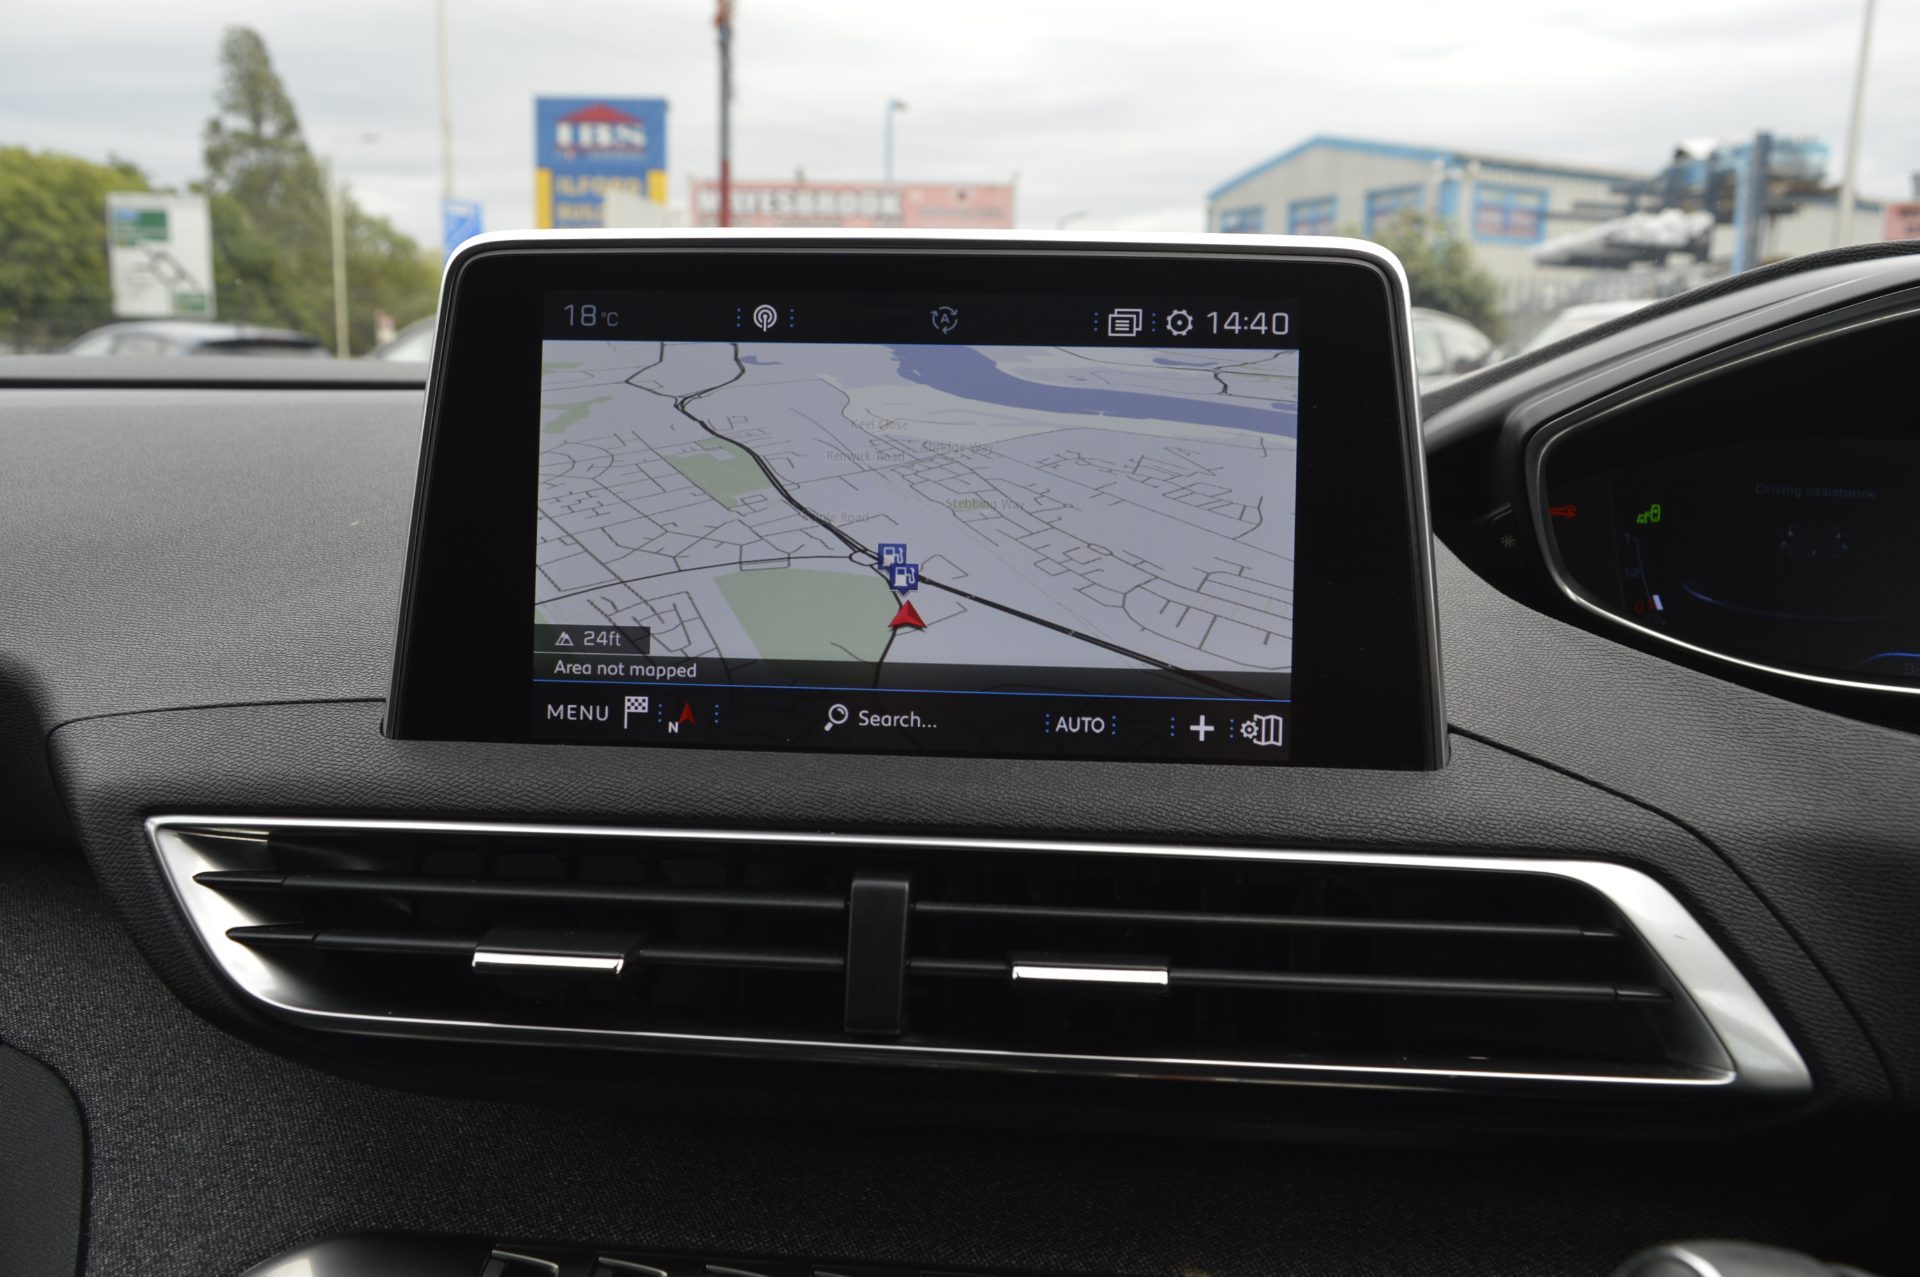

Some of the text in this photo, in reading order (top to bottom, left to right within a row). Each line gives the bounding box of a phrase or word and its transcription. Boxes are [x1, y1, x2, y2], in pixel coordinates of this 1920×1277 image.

[1206, 311, 1289, 335] 14:40
[1754, 480, 1877, 500] Driving assistance
[583, 631, 622, 647] 24ft
[554, 659, 698, 682] Area not mapped
[546, 704, 610, 722] MENU
[668, 721, 679, 734] N
[1055, 717, 1105, 734] AUTO
